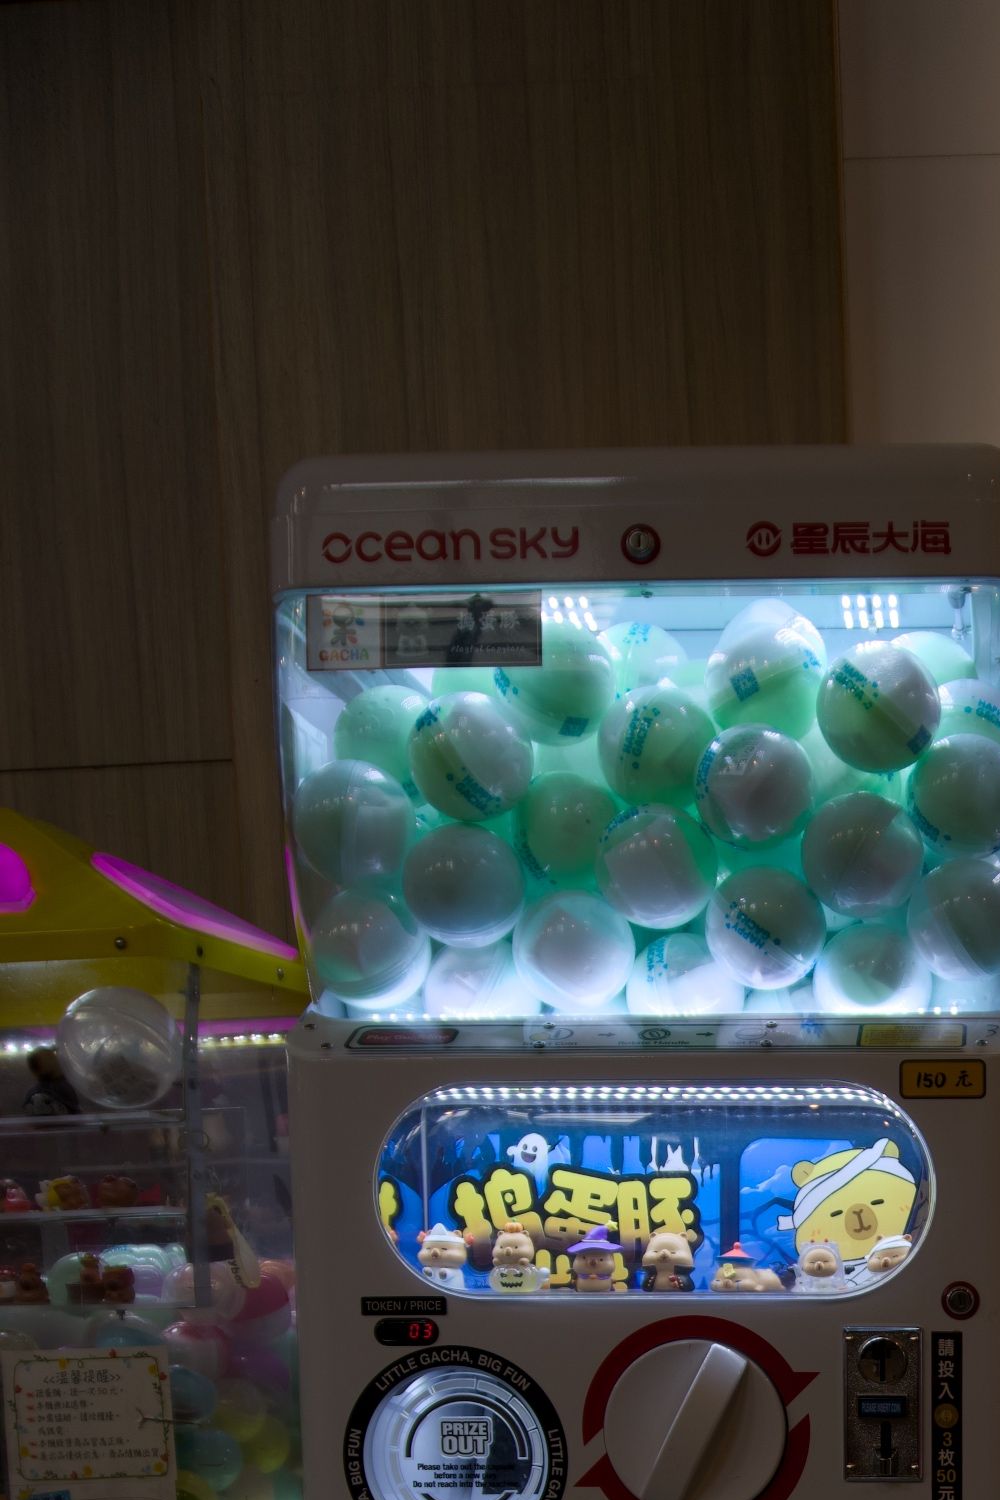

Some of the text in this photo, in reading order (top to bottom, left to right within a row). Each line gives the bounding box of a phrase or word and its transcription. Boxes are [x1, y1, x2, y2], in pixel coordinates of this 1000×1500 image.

[790, 520, 952, 557] 星辰大海
[319, 648, 370, 662] GACHA
[916, 1070, 973, 1089] 150 元
[366, 1300, 442, 1311] TOKEN PRICE
[408, 1323, 434, 1340] 03
[375, 1358, 416, 1392] LITTLE
[477, 1353, 503, 1373] BIG
[503, 1365, 531, 1392] FUN
[441, 1420, 488, 1436] PRIZE
[441, 1436, 489, 1455] OUT
